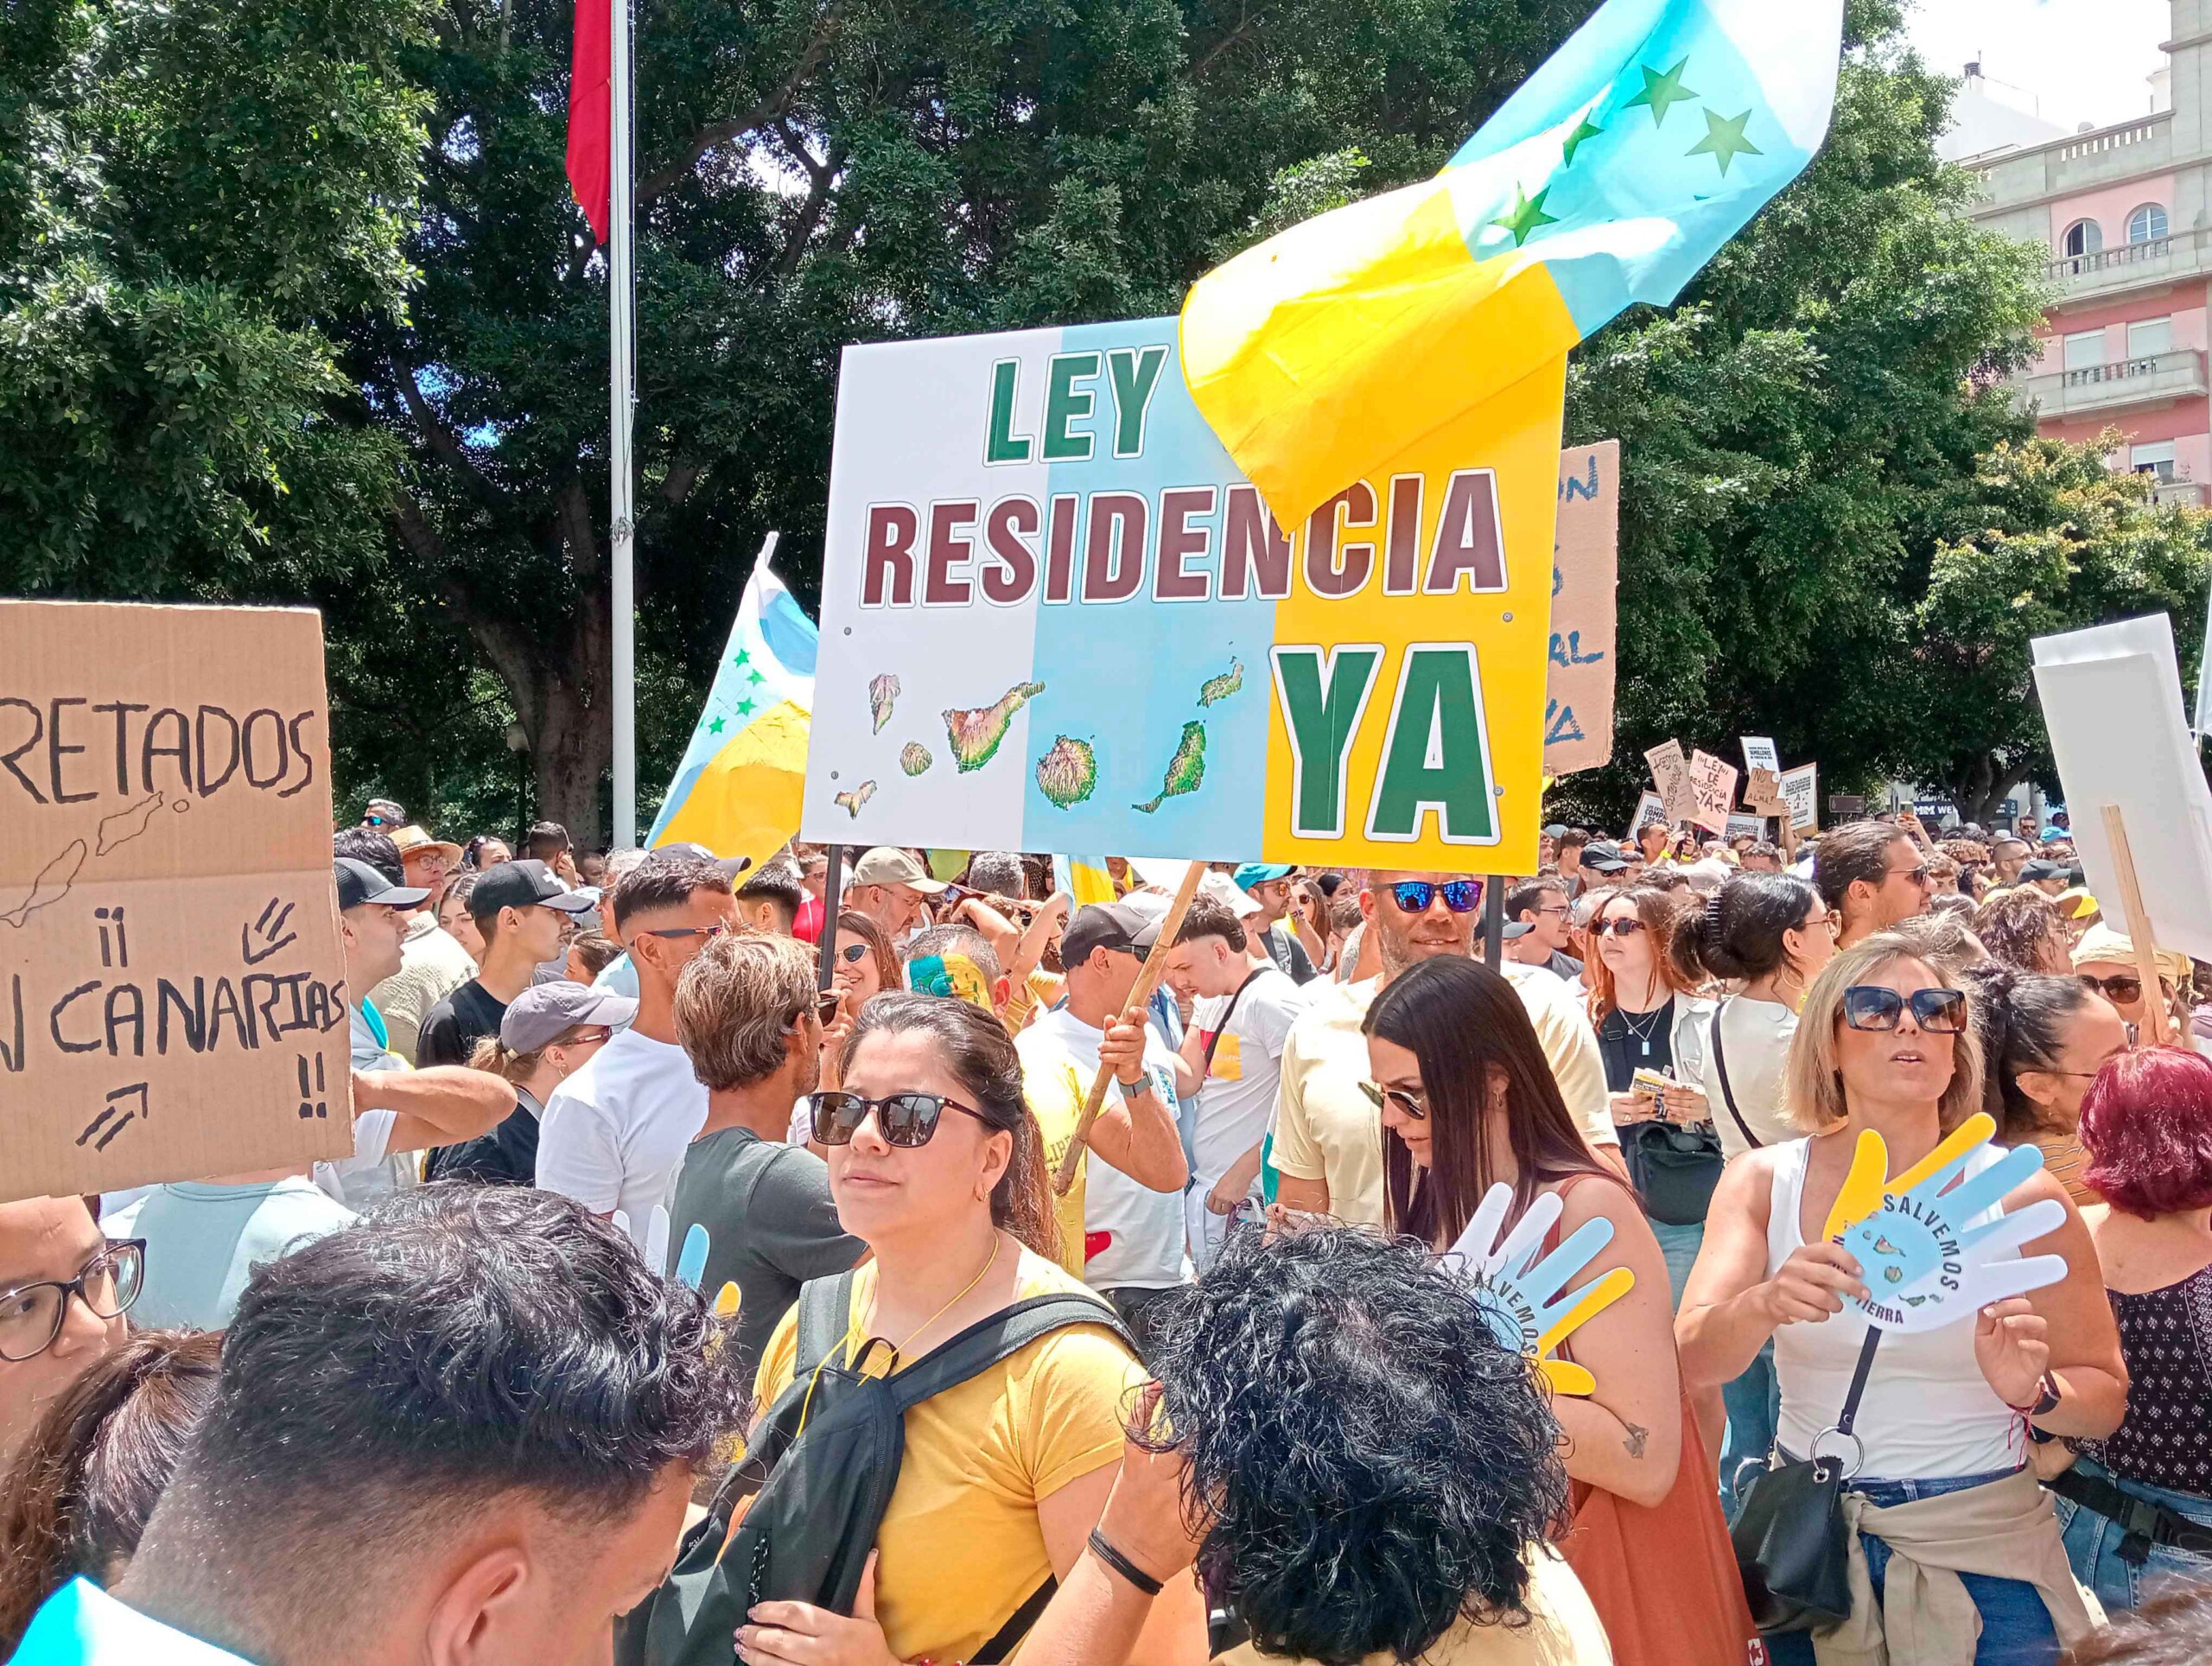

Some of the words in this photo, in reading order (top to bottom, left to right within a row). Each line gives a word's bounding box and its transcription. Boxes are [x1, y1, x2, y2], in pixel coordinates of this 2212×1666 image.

[985, 346, 1170, 466] LEY
[861, 468, 1509, 607] RESIDENCIA
[1271, 644, 1500, 843] YA
[1707, 773, 1719, 786] DE
[1699, 790, 1713, 812] YA
[50, 972, 346, 1057] CANARIAS
[1882, 1193, 1962, 1290] SALVEMOS
[1473, 1270, 1539, 1356] ALVEMOS
